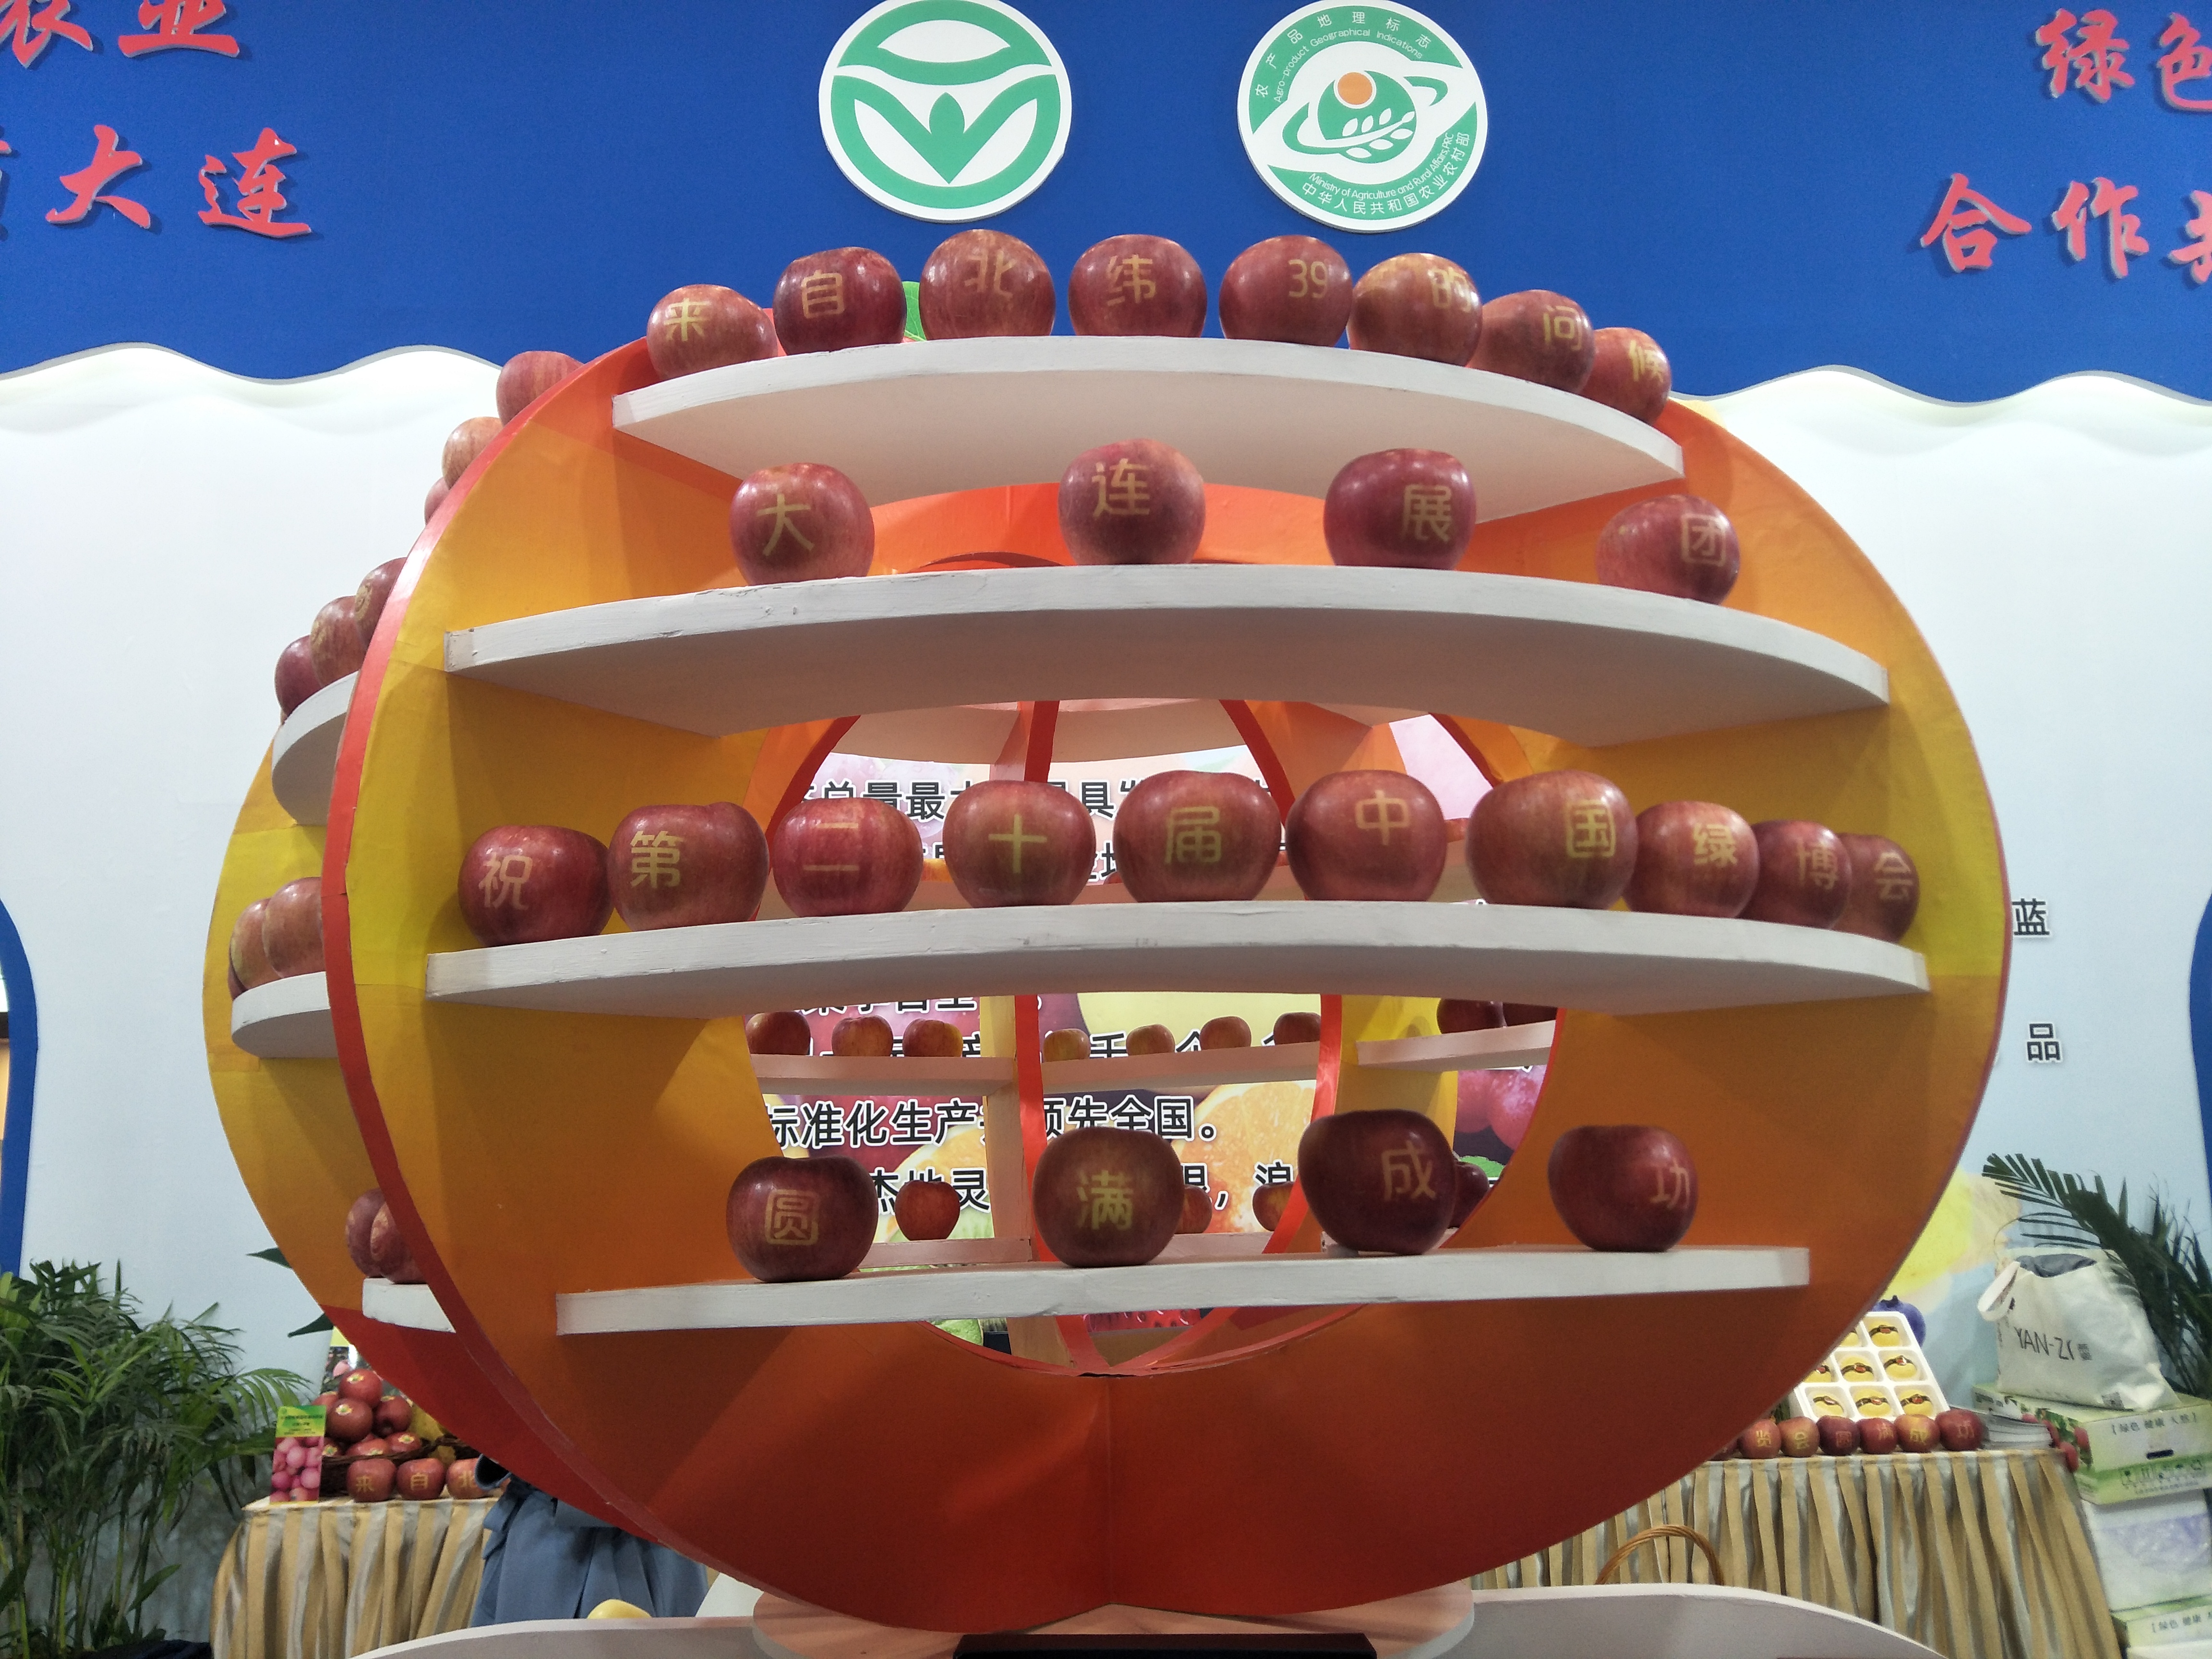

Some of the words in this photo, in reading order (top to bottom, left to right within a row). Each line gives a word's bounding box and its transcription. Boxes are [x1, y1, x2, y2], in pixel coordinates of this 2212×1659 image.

[1255, 11, 1431, 98] 农产品地理标志
[1274, 46, 1310, 103] Agro-product
[1310, 29, 1370, 47] Geographical
[1377, 31, 1423, 59] Indications
[2036, 8, 2212, 112] 绿色
[0, 125, 312, 239] 大连
[1302, 132, 1470, 215] 中华人民共和国农业农村部
[1309, 173, 1341, 193] Ministry
[1341, 188, 1351, 197] of
[1351, 189, 1396, 201] Agriculture
[1397, 182, 1414, 194] and
[1412, 168, 1432, 186] Rural
[664, 297, 710, 342] 来
[801, 269, 845, 319] 自
[964, 250, 1018, 299] 北
[1106, 253, 1156, 306] 纬
[1287, 258, 1328, 299] 39
[1627, 338, 1664, 383] 候
[756, 493, 815, 556] 大
[1092, 458, 1152, 517] 连
[1401, 483, 1452, 544] 展
[1681, 512, 1727, 567] 团
[478, 851, 533, 911] 祝
[630, 830, 686, 890] 第
[988, 813, 1047, 874] 十
[1165, 805, 1223, 865] 届
[1355, 789, 1409, 846] 中
[1565, 799, 1616, 859] 国
[1796, 841, 1839, 891] 博
[1874, 851, 1913, 902] 会
[2011, 897, 2050, 937] 蓝
[2025, 1022, 2062, 1062] 品
[765, 1188, 819, 1247] 圆
[1076, 1169, 1135, 1231] 满
[1381, 1140, 1437, 1201] 成
[1649, 1158, 1690, 1209] 功
